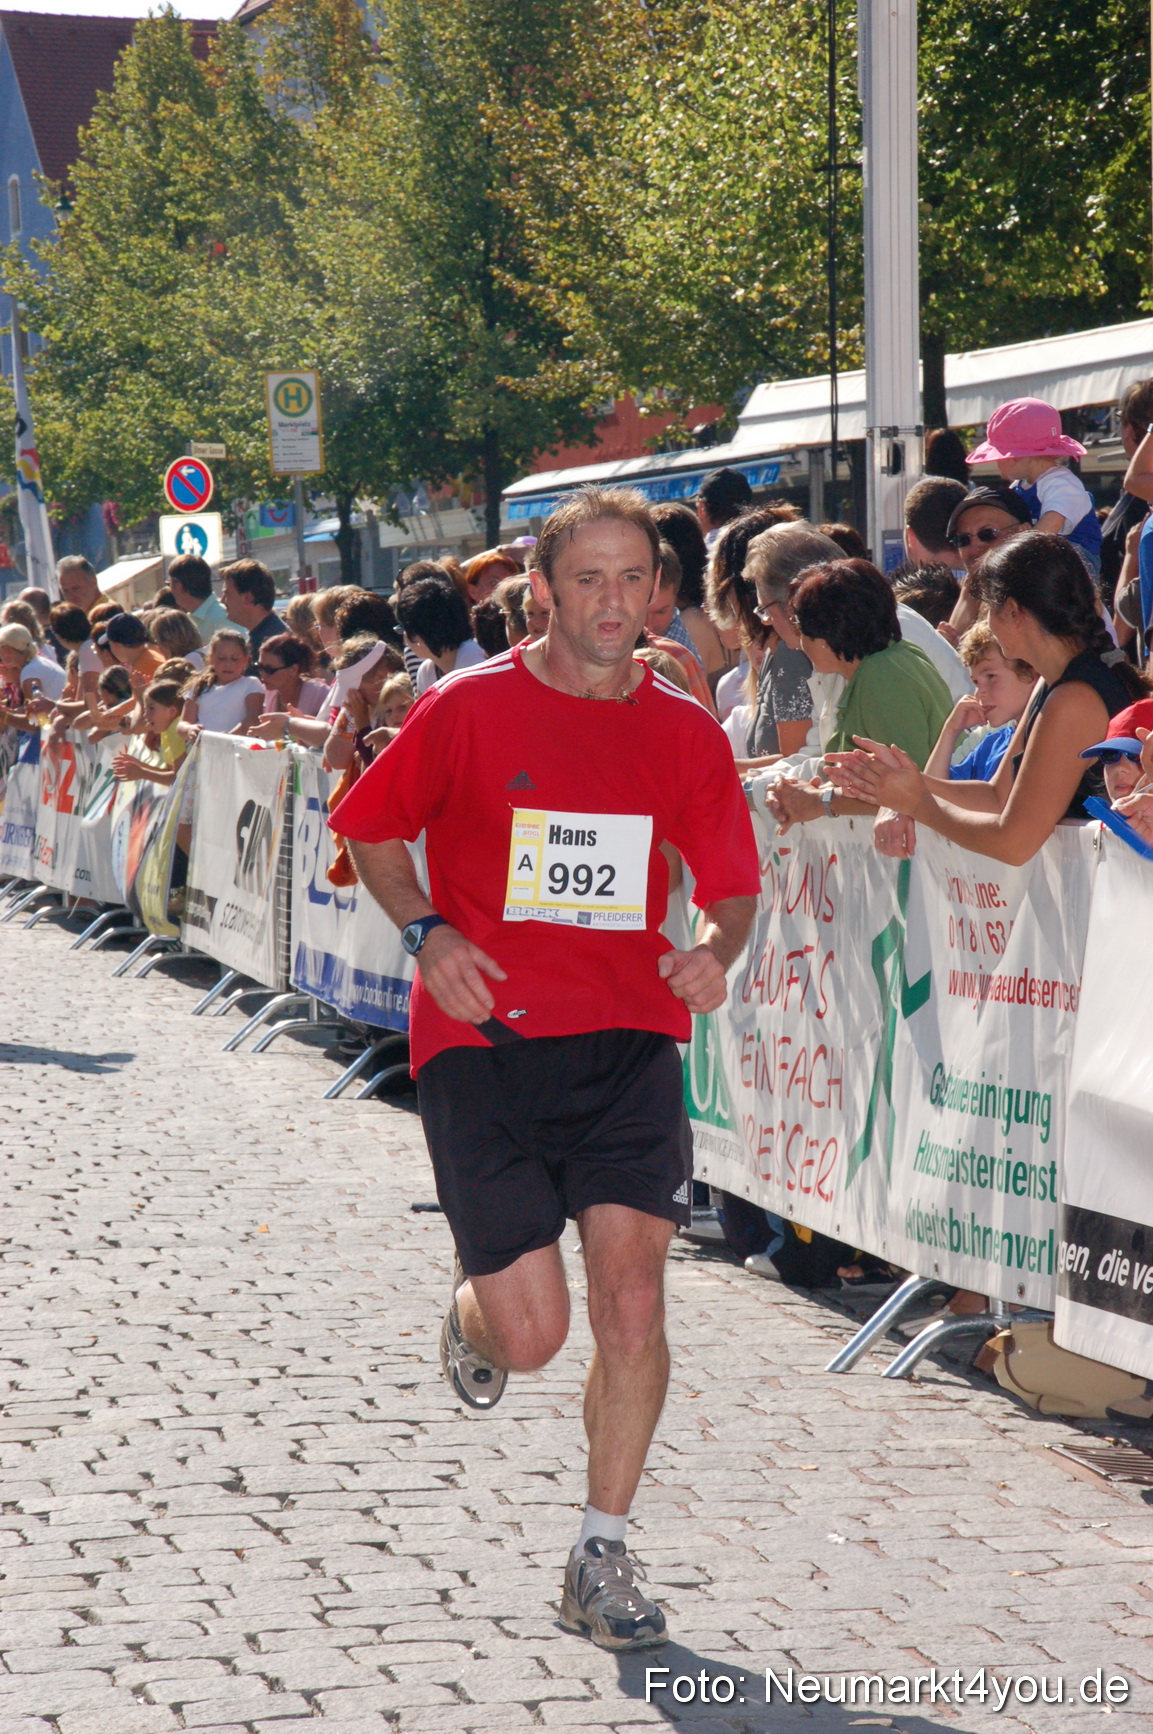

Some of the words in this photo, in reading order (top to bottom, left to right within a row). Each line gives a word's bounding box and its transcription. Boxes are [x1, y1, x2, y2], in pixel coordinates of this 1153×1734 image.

[284, 386, 303, 409] H
[278, 421, 311, 429] Marktplatz
[548, 824, 598, 847] Hans
[517, 853, 534, 872] A
[547, 862, 616, 897] 992
[506, 906, 560, 919] BOCK
[593, 911, 643, 922] PFLEIDERER
[1097, 1248, 1131, 1287] die
